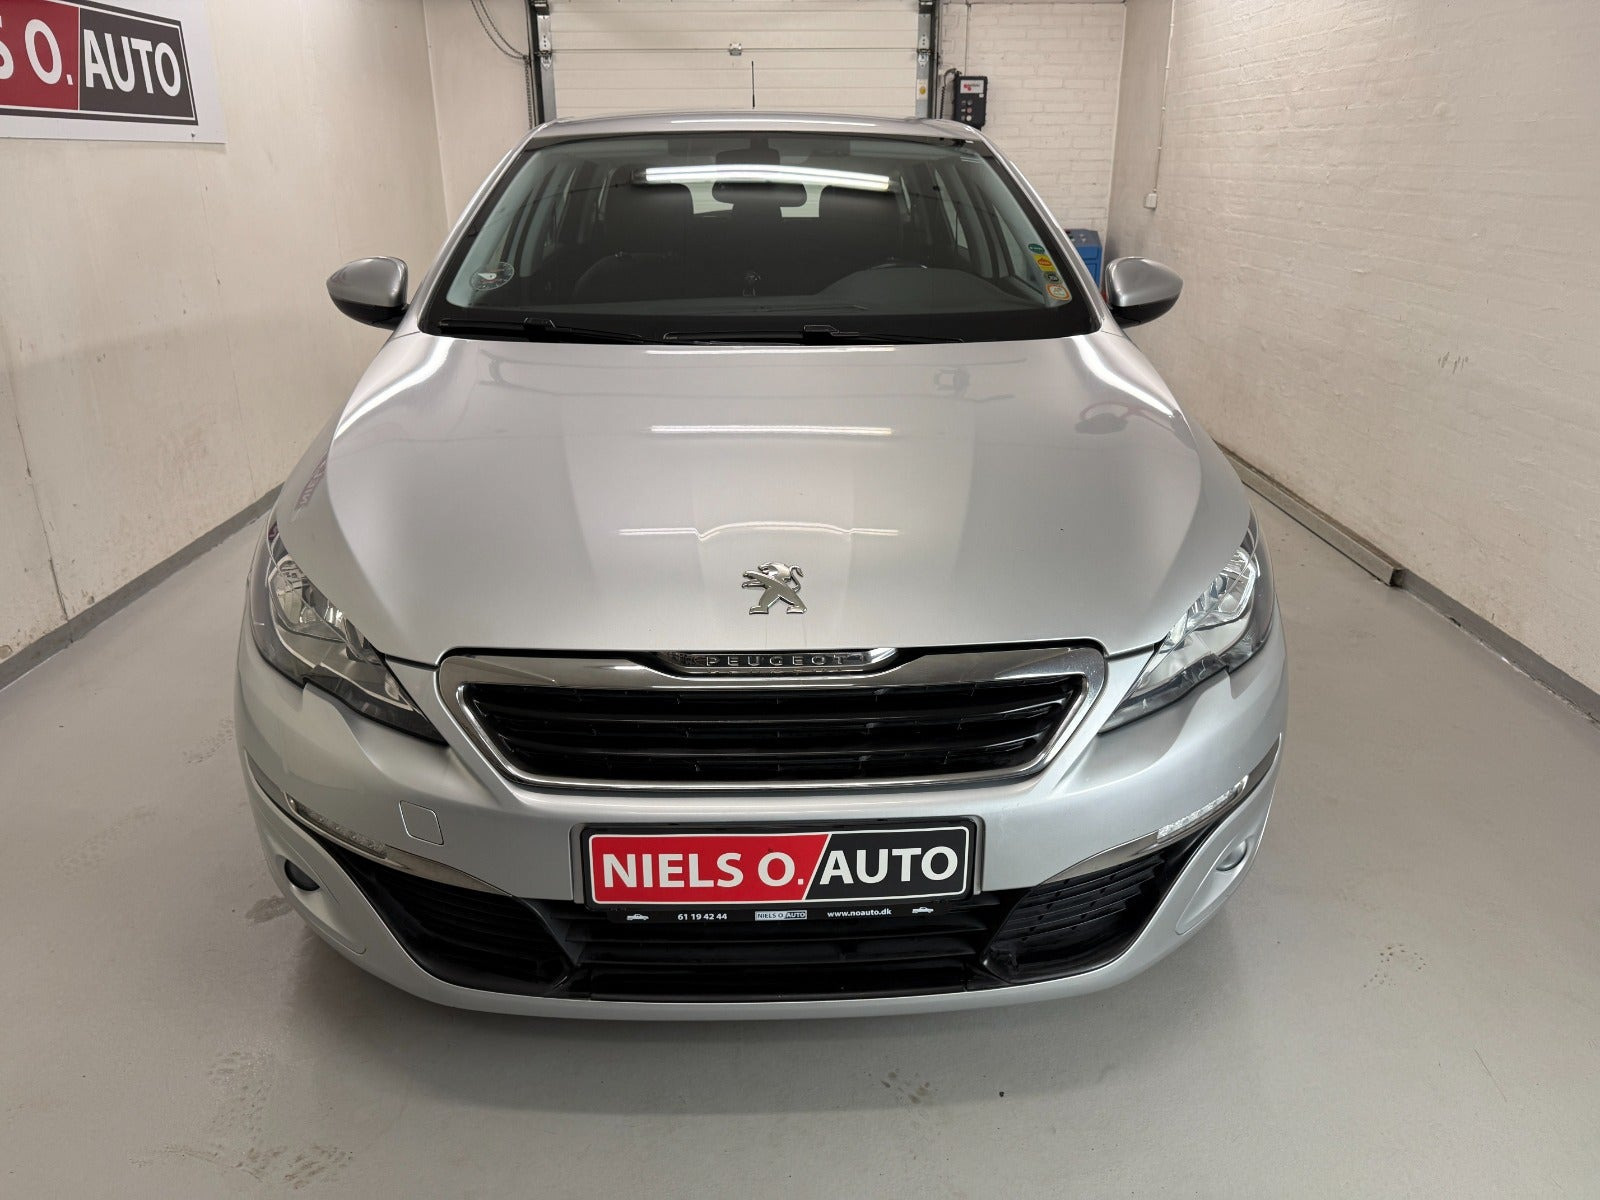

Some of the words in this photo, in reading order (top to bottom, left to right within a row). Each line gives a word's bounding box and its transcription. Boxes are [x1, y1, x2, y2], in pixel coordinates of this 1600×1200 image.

[25, 18, 73, 85] O.
[83, 28, 181, 97] AUTO
[706, 653, 846, 667] PEUGEOT
[602, 853, 743, 888] NIELS
[757, 852, 804, 887] O.
[819, 846, 958, 885] AUTO
[827, 908, 892, 917] www.noauto.dk
